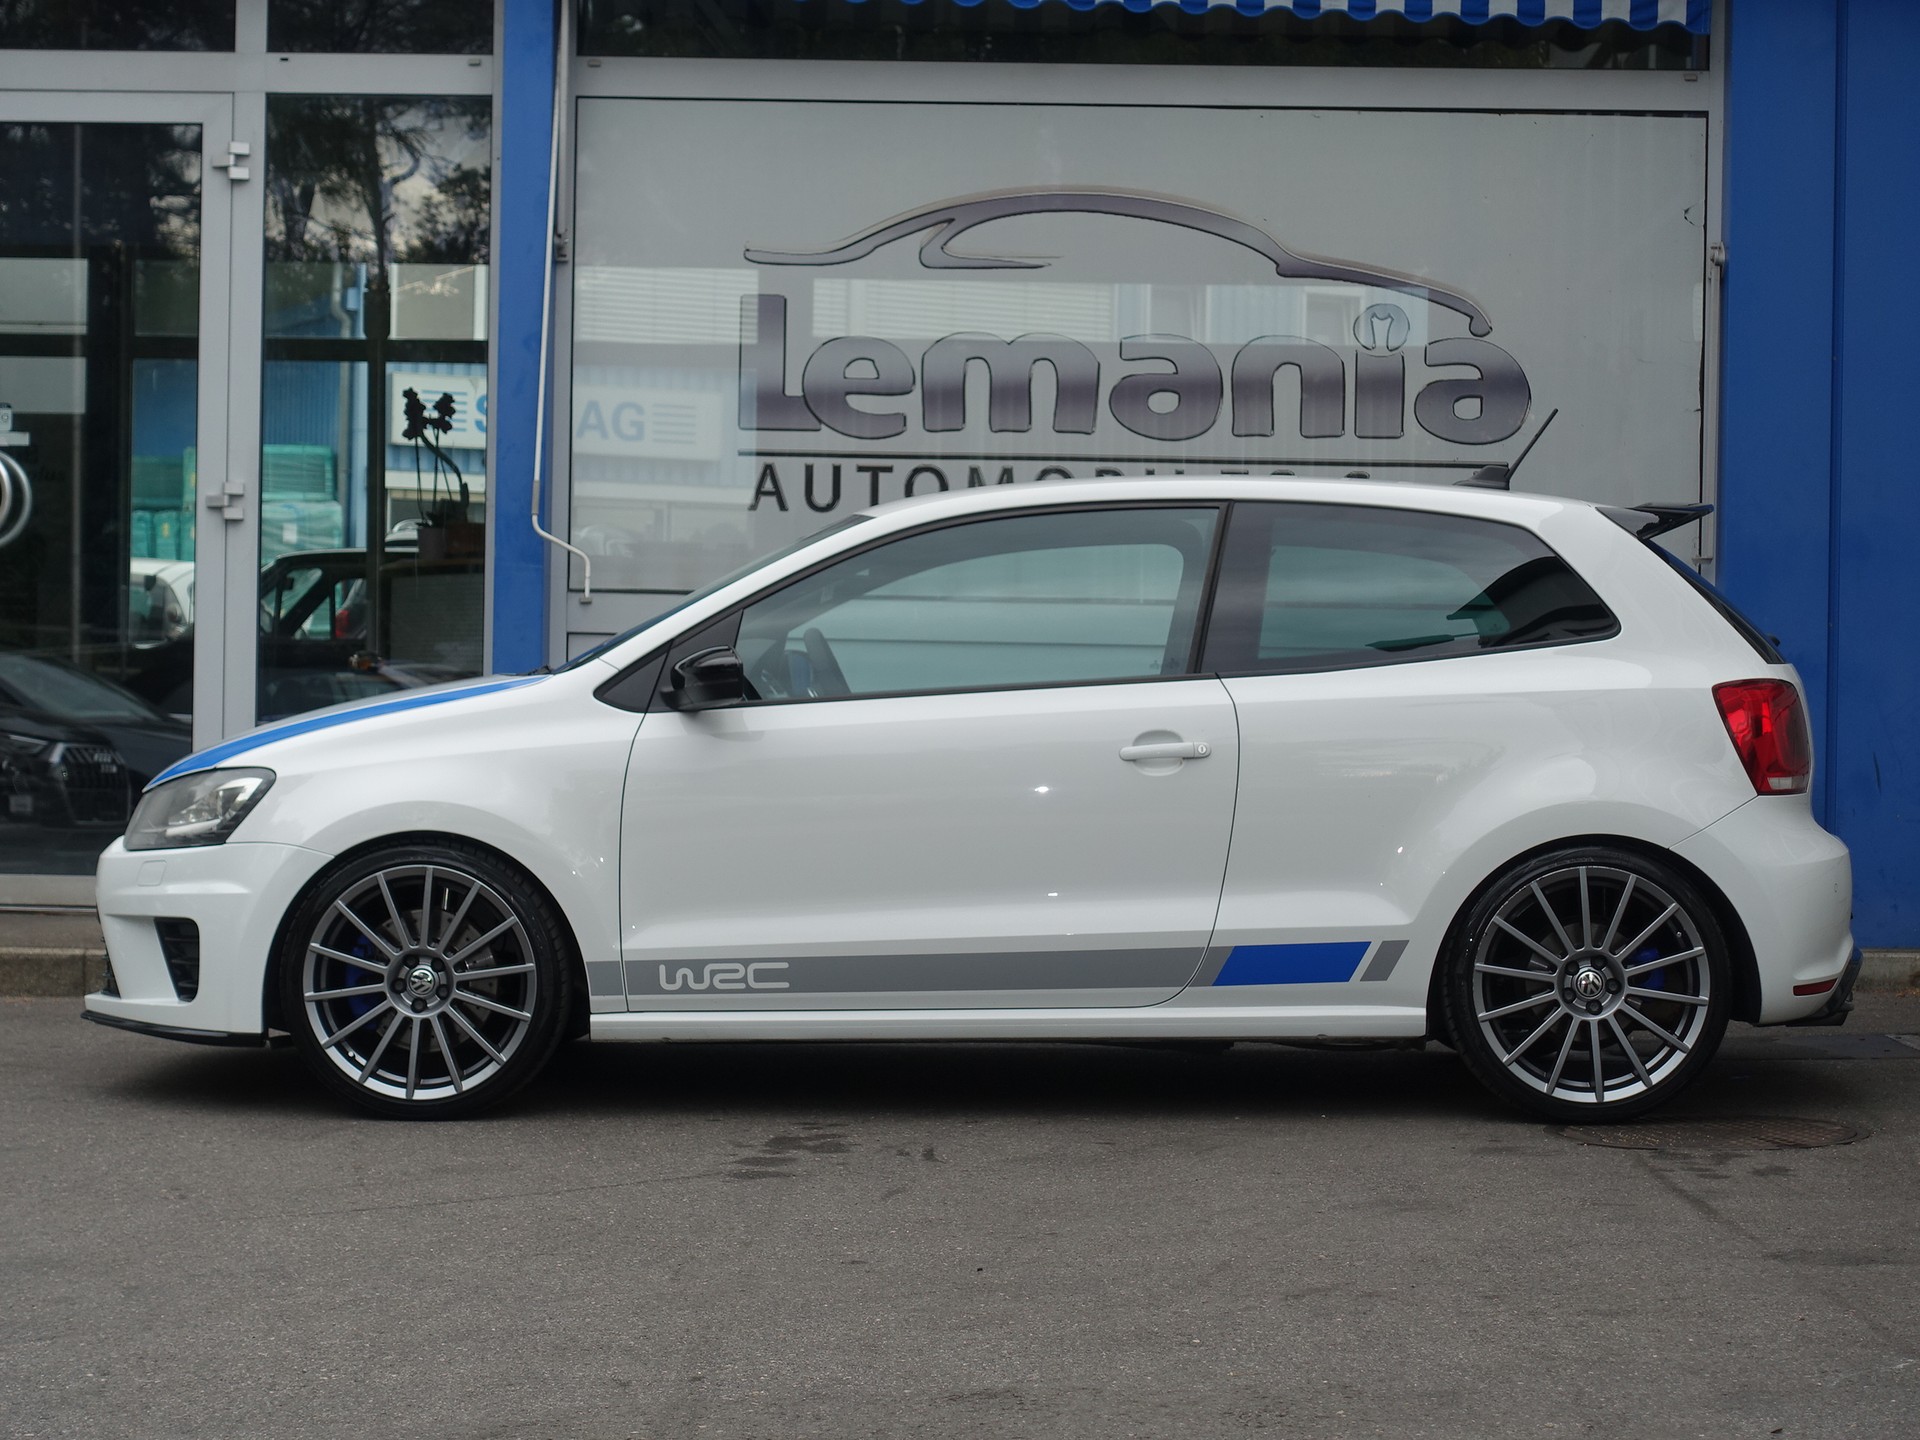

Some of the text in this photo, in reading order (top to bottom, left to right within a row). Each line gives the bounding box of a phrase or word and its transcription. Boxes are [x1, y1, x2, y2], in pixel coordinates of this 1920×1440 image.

[738, 293, 1532, 445] Lemania
[576, 401, 646, 442] AG
[659, 962, 790, 991] WRC
